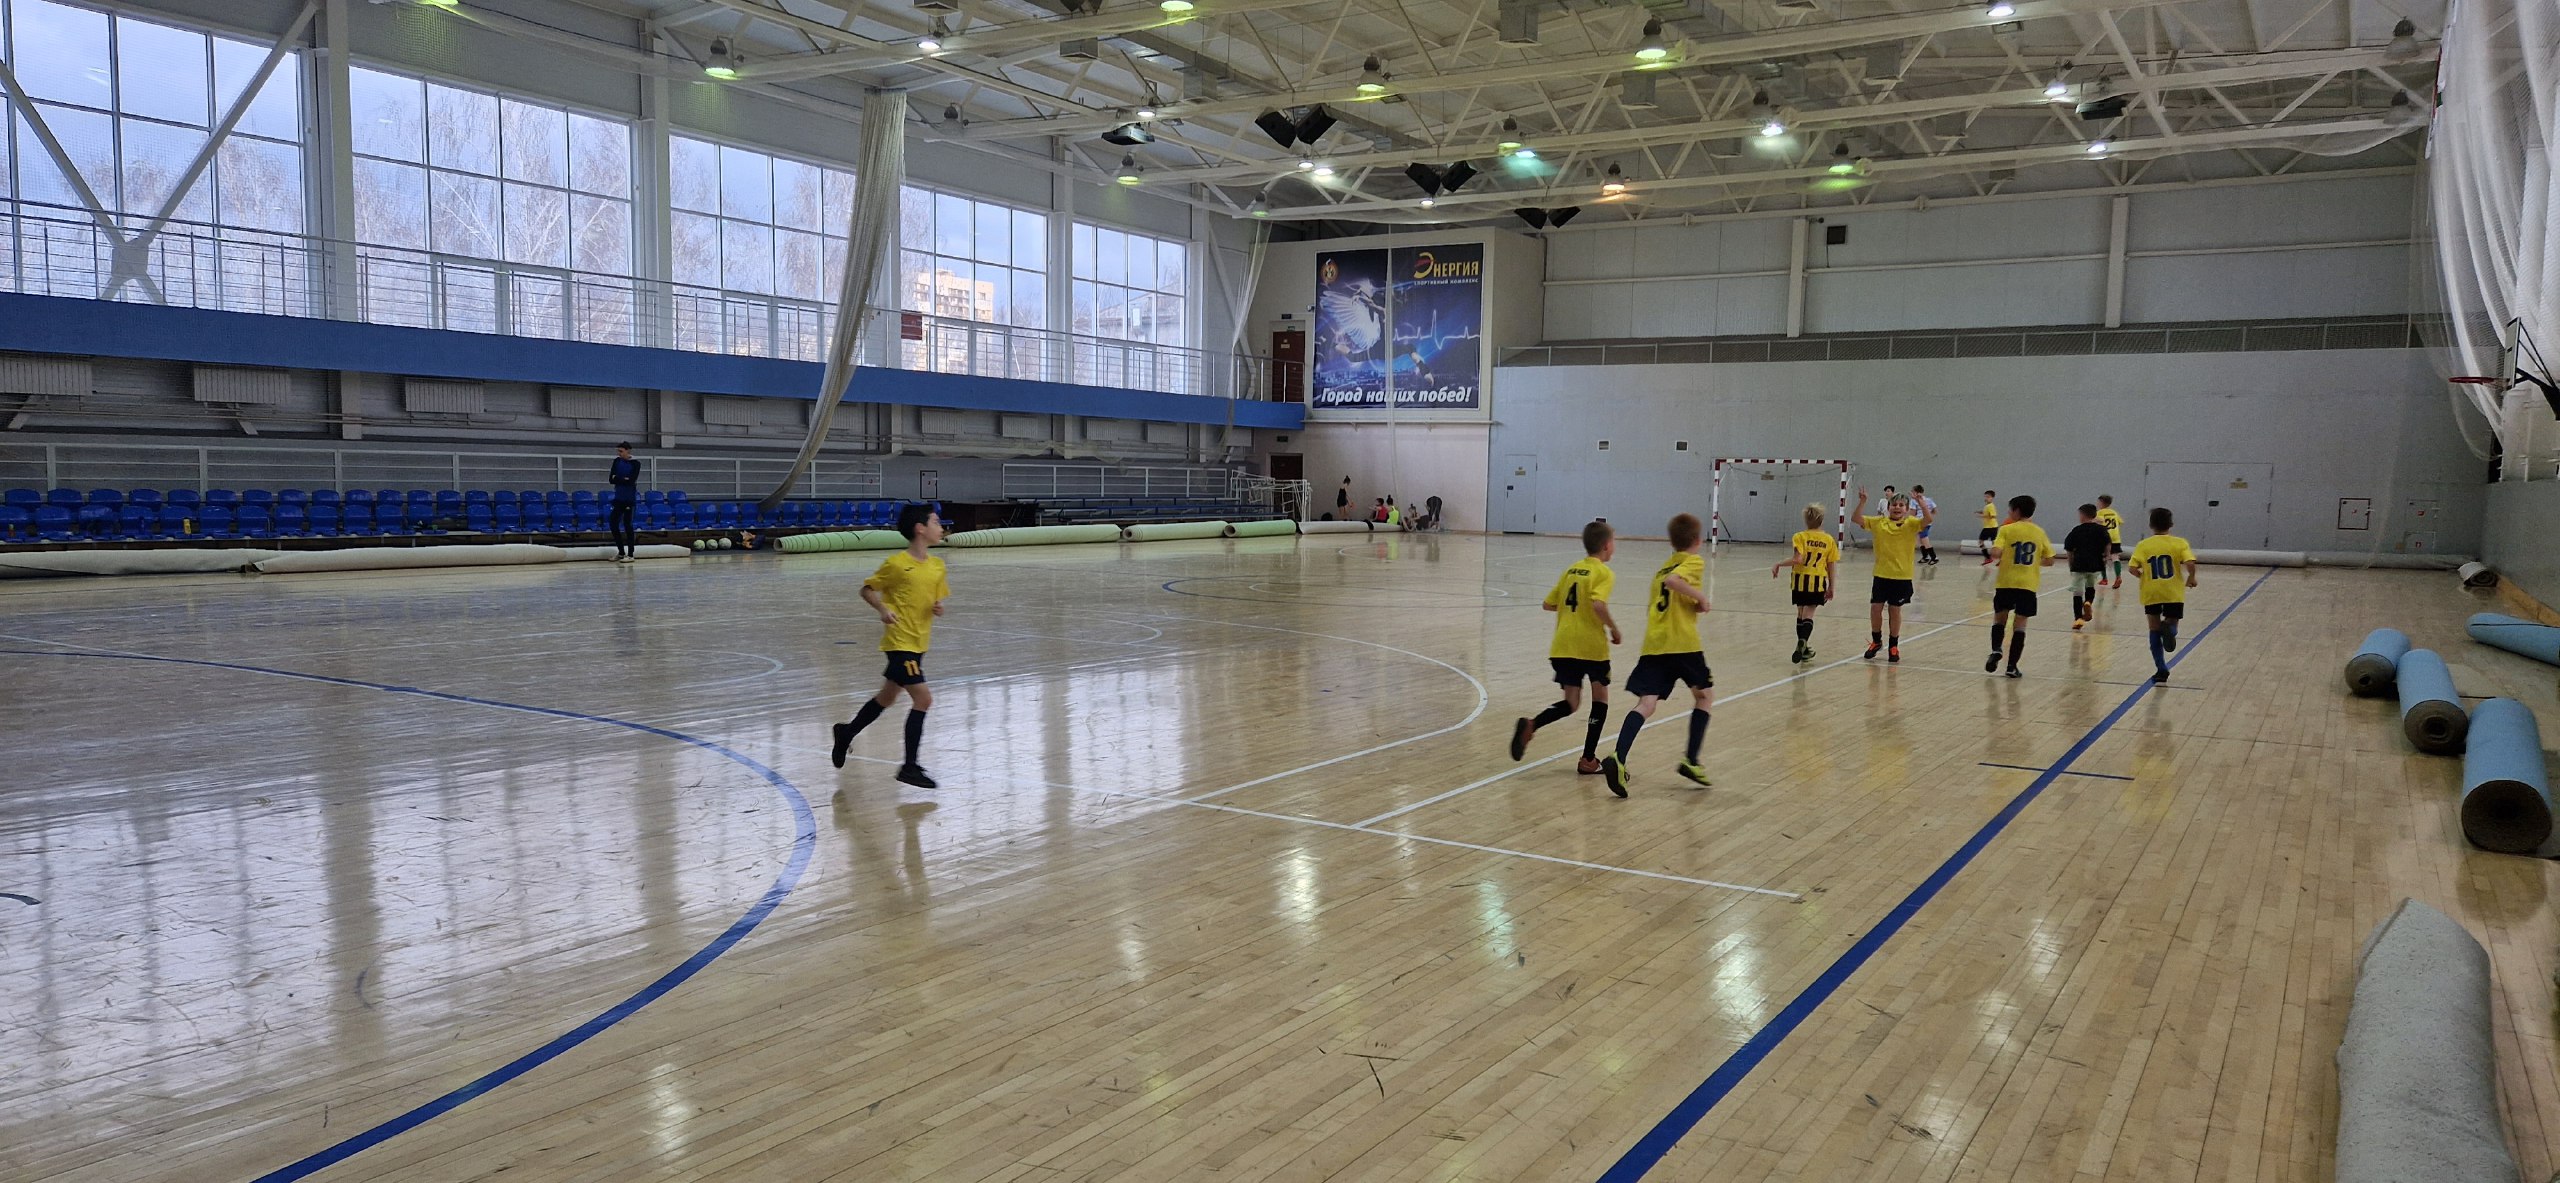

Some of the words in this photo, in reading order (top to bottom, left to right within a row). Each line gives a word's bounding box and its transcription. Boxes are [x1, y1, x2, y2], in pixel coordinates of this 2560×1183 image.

[1413, 252, 1479, 279] ЭНЕРГИЯ
[1321, 387, 1363, 406] Город
[1418, 386, 1473, 403] побед!
[2011, 541, 2037, 565] 18
[2147, 554, 2174, 580] 10
[1565, 582, 1578, 612] 4
[1656, 581, 1670, 612] 5
[903, 660, 921, 676] 11
